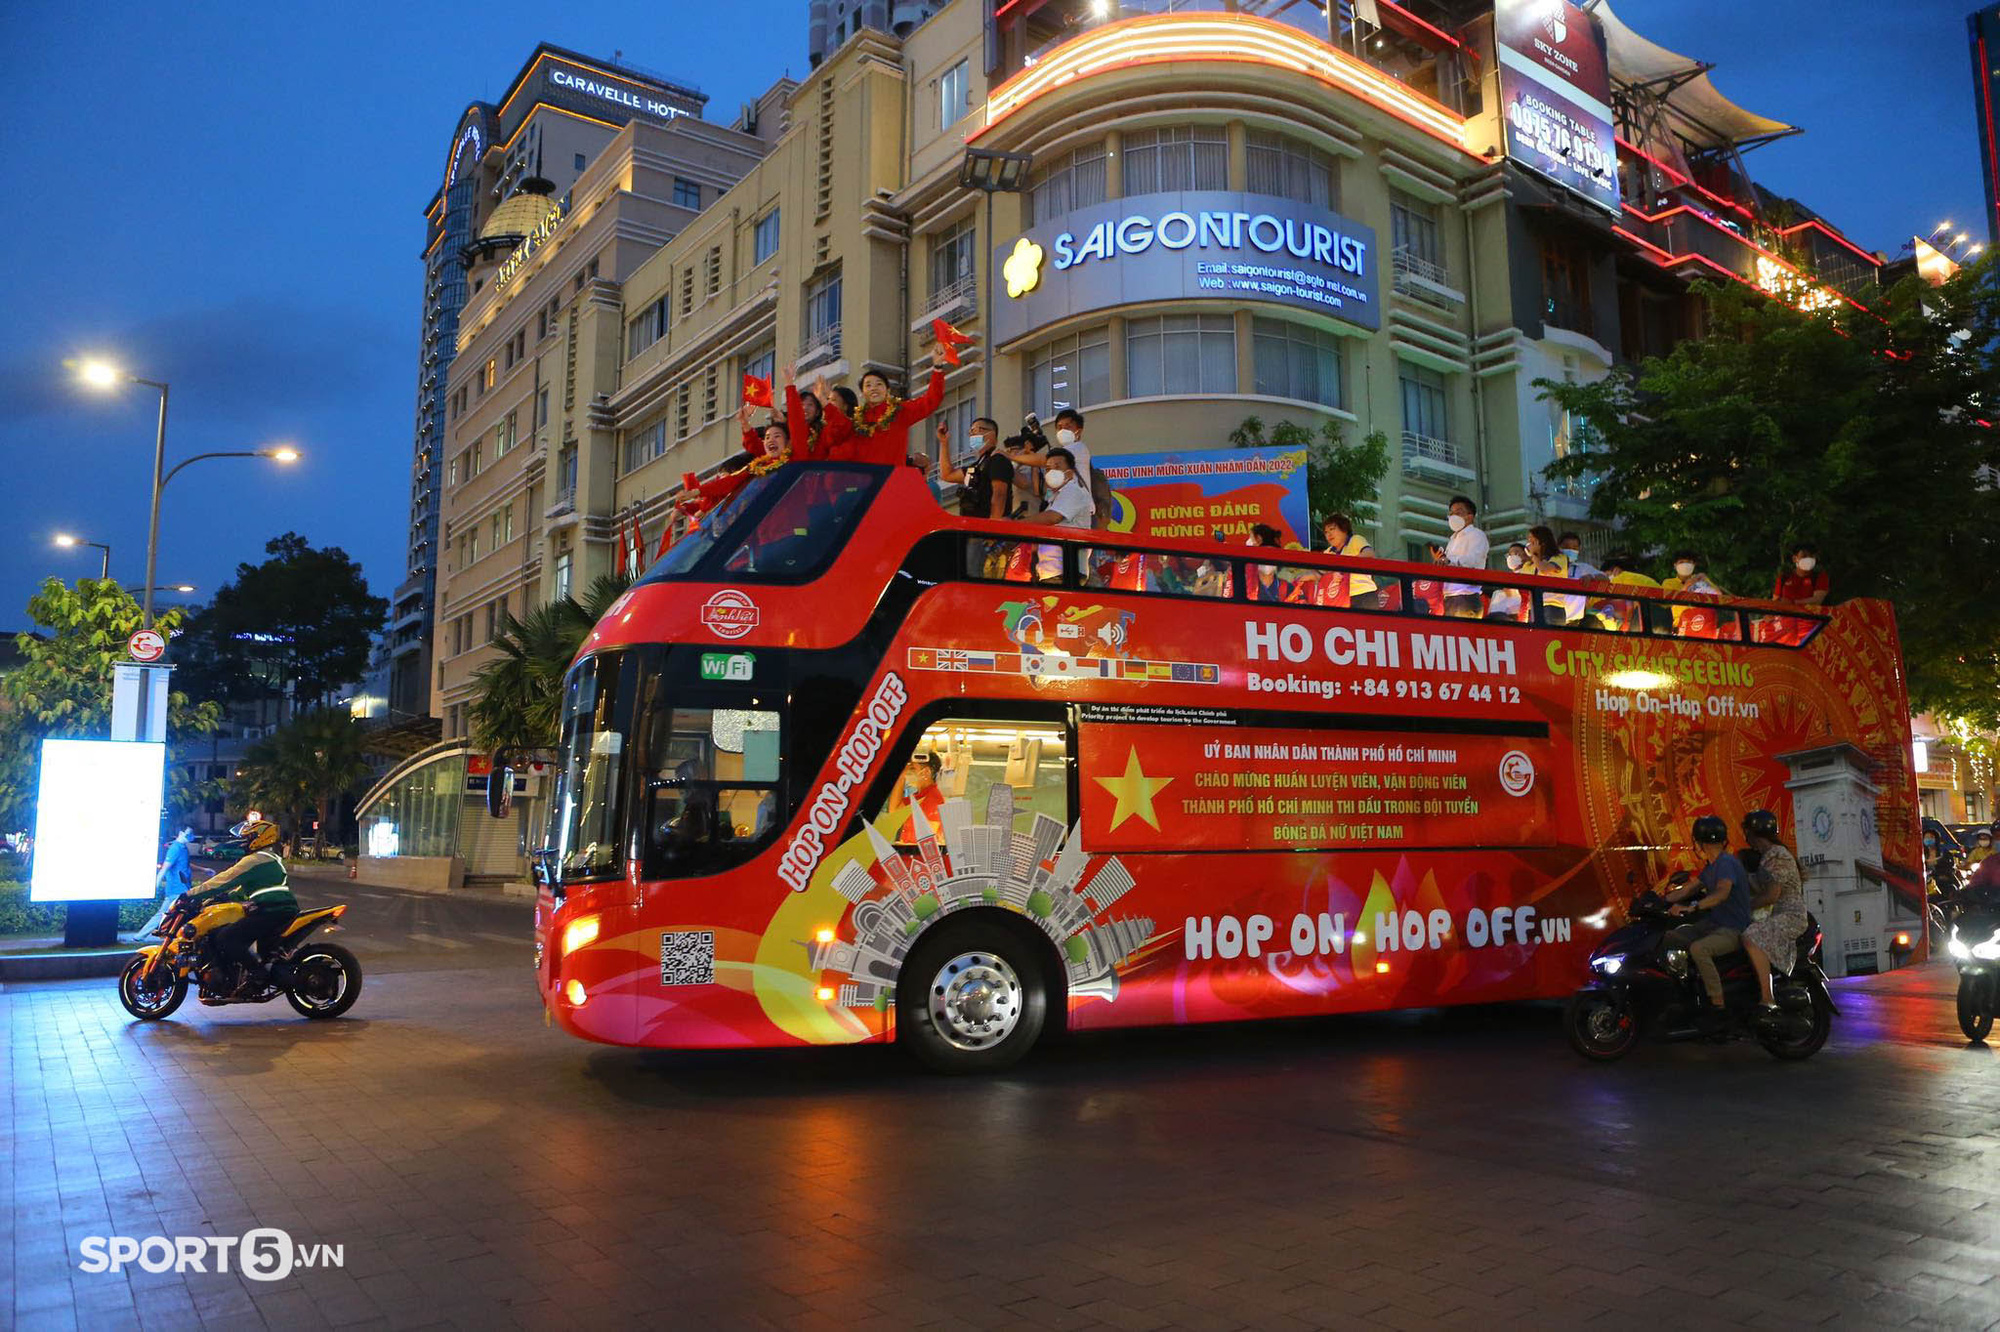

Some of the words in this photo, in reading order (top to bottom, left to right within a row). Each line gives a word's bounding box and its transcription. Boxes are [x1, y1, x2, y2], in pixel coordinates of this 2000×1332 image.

[1534, 38, 1552, 56] SKY
[1553, 48, 1579, 73] ZONE
[553, 71, 641, 109] CARAVELLE
[1525, 94, 1568, 126] BOOKING
[1569, 118, 1596, 143] TABLE
[1573, 162, 1590, 178] LIVE
[1054, 211, 1367, 276] SAIGONTOURIST
[1131, 466, 1154, 478] VINH
[1187, 461, 1213, 475] XUÂN
[1268, 459, 1293, 472] 2022
[1150, 504, 1204, 519] MỪNG
[1151, 523, 1205, 537] MỪNG
[1245, 620, 1314, 663] HO
[1324, 627, 1400, 668] CHI
[1410, 632, 1517, 675] MINH
[1247, 672, 1342, 699] Booking:
[1349, 679, 1390, 698] +84
[1396, 680, 1433, 700] 913
[1438, 682, 1463, 701] 67
[1468, 684, 1492, 702] 44
[1499, 686, 1521, 704] 12
[1595, 689, 1629, 717] Hop
[1707, 695, 1759, 719] Off.vn
[1081, 712, 1104, 721] Priority
[1105, 713, 1128, 722] project
[1136, 715, 1159, 723] develop
[1203, 717, 1237, 725] Government
[1224, 744, 1251, 759] BAN
[1254, 742, 1289, 760] NHÂN
[1292, 743, 1317, 760] DÂN
[1320, 744, 1359, 761] THÀNH
[1362, 743, 1385, 761] PHỐ
[1406, 746, 1425, 763] CHÍ
[1428, 749, 1457, 764] MINH
[1194, 770, 1230, 787] CHÀO
[1233, 770, 1270, 787] MỪNG
[1274, 769, 1307, 788] HUẤN
[1311, 771, 1348, 791] LUYỆN
[1351, 772, 1381, 790] VIÊN,
[1442, 774, 1467, 790] VIÊN
[1182, 797, 1225, 814] THÀNH
[1228, 794, 1254, 814] PHỐ
[1277, 797, 1298, 814] CHÍ
[1301, 800, 1333, 814] MINH
[1337, 800, 1355, 814] THI
[1358, 795, 1381, 814] ĐẤU
[1384, 800, 1421, 814] TRONG
[1424, 798, 1442, 816] ĐỘI
[1445, 796, 1479, 815] TUYỂN
[1273, 823, 1307, 840] BÓNG
[1310, 823, 1327, 840] ĐÁ
[1350, 823, 1374, 842] VIỆT
[1377, 825, 1403, 840] NAM
[1184, 914, 1274, 961] HOP
[1290, 912, 1345, 957] ON
[1375, 908, 1452, 953] HOP
[1466, 905, 1572, 948] OFF.VN
